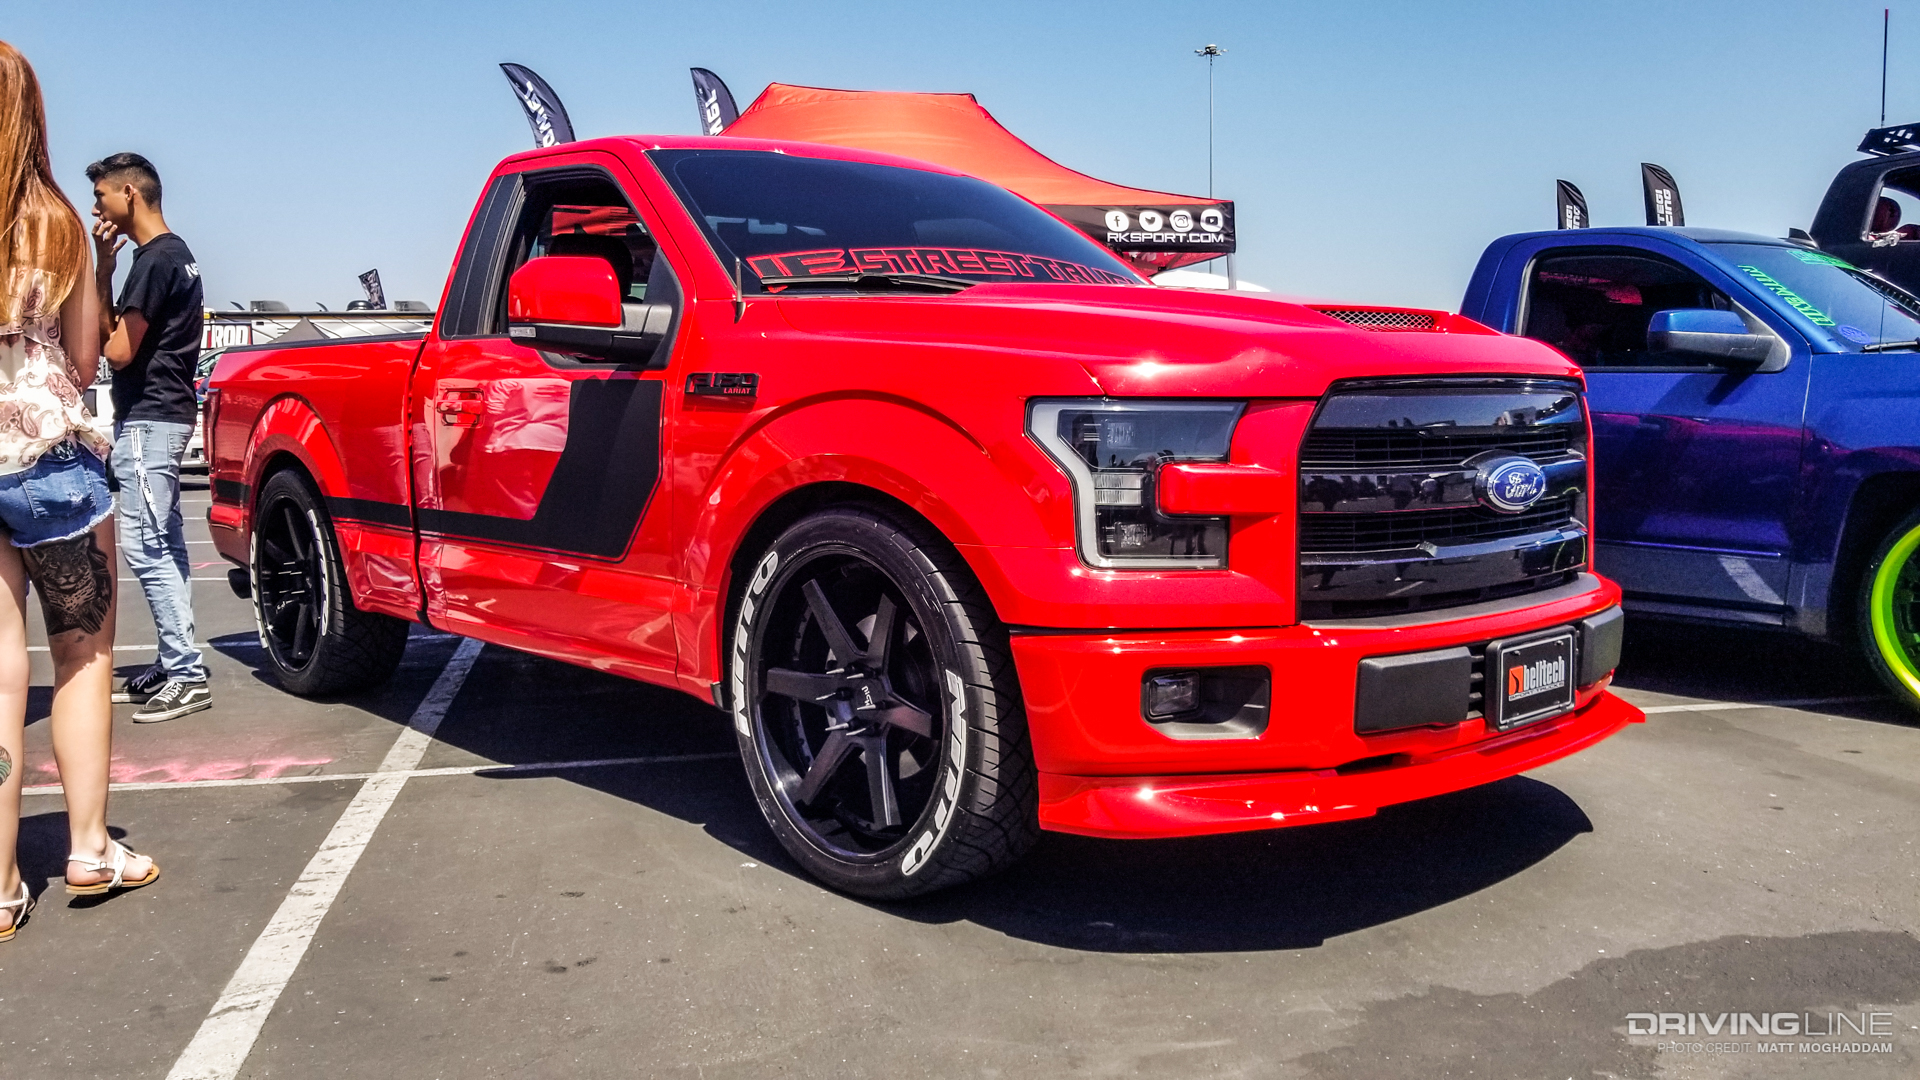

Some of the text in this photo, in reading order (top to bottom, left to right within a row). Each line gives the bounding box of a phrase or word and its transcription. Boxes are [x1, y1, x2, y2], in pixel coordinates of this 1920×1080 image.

[1654, 188, 1665, 227] TEGI
[1662, 188, 1674, 227] CING
[1106, 232, 1224, 243] RKSPORT.COM
[848, 247, 1035, 278] STREET
[1523, 655, 1565, 691] belltech
